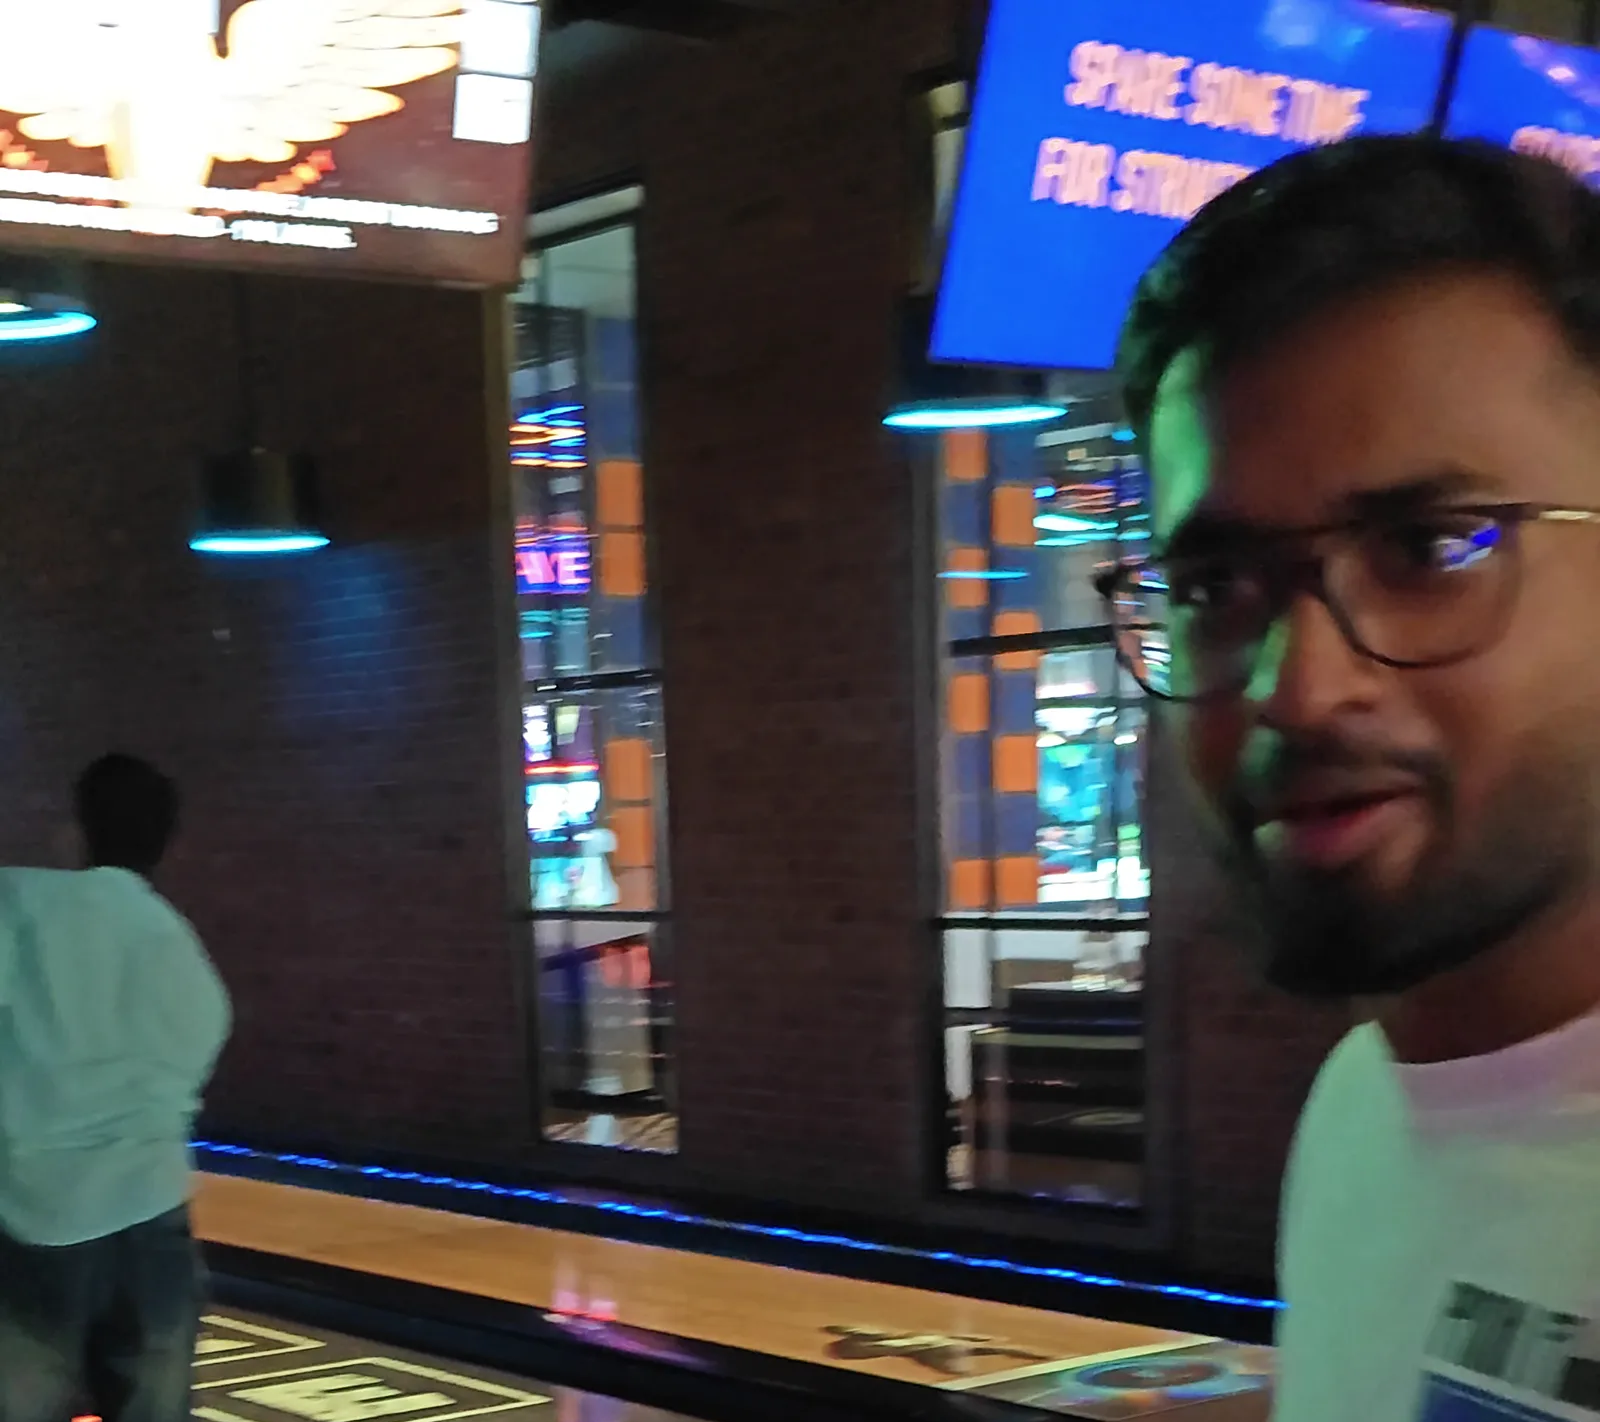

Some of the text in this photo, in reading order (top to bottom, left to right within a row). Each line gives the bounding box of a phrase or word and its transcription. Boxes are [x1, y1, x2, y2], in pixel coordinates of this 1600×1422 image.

[1065, 40, 1371, 145] SPARE SOME TIME
[1031, 137, 1116, 208] FOR
